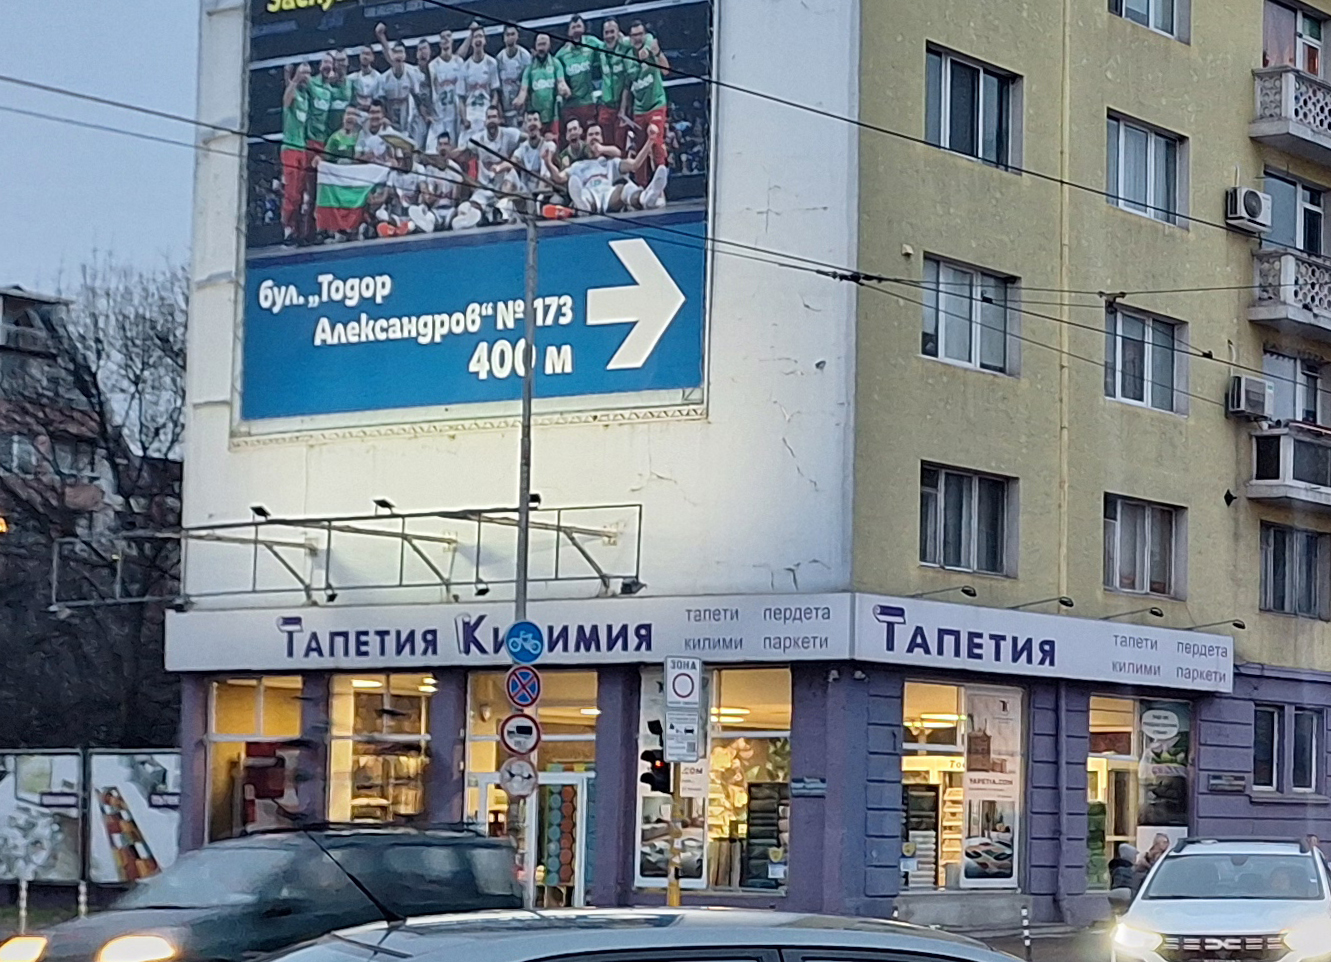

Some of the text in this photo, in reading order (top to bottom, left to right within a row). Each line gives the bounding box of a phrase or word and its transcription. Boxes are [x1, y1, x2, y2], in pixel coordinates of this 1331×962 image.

[258, 279, 305, 314] бул.
[532, 295, 574, 327] 173
[685, 605, 831, 625] тапети пердета
[455, 613, 653, 656] КИИМИЯ
[684, 635, 829, 653] килими паркети
[1113, 634, 1228, 658] тапети пердета
[670, 660, 697, 671] ЗОНА
[1111, 661, 1226, 683] килими паркети
